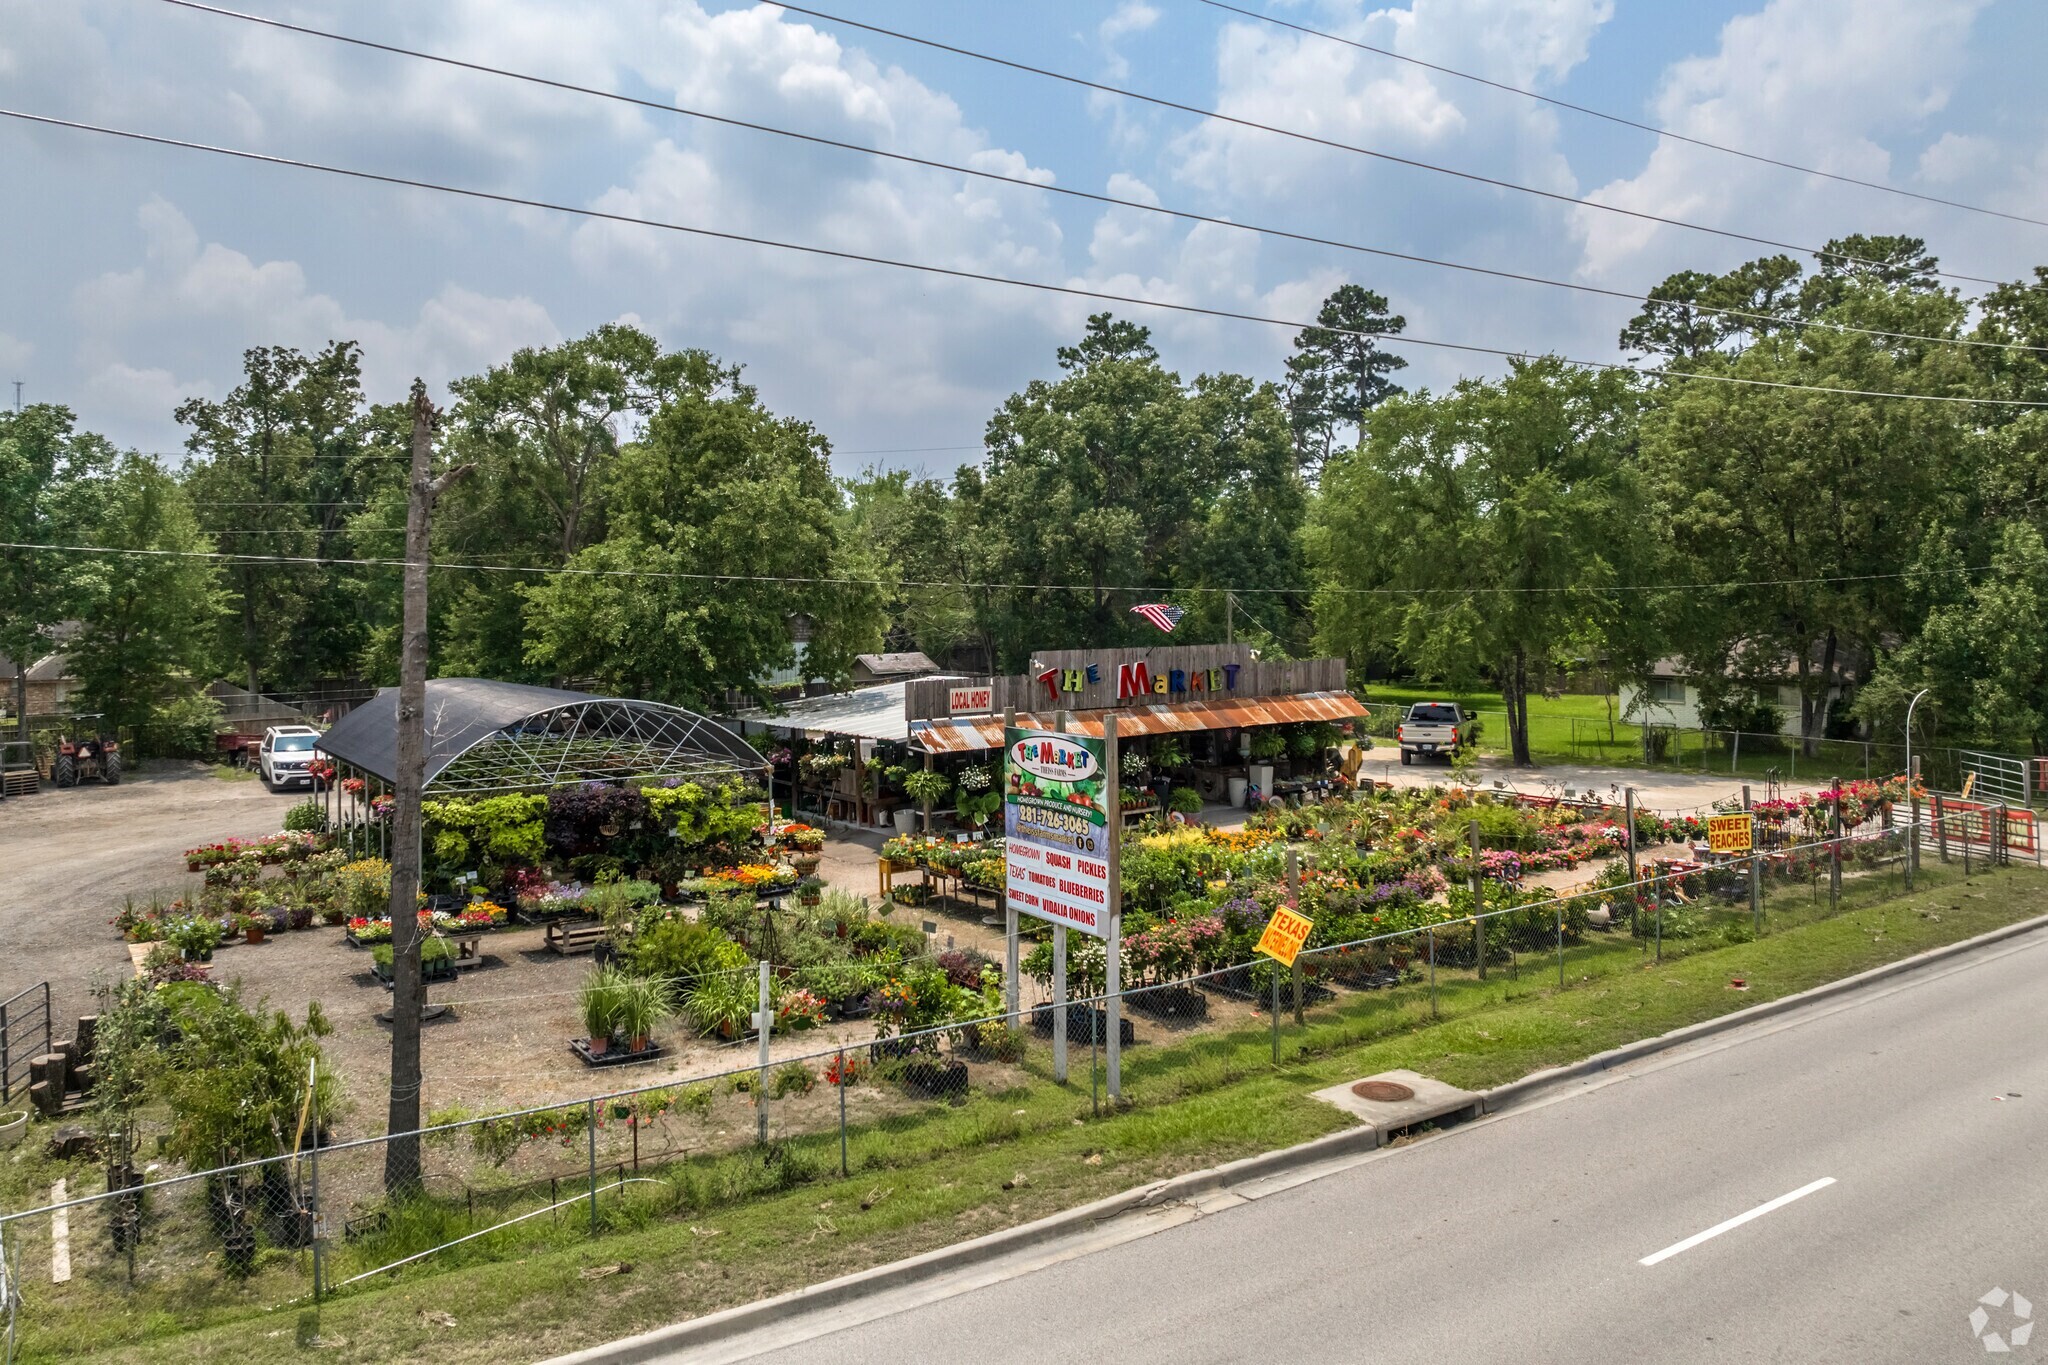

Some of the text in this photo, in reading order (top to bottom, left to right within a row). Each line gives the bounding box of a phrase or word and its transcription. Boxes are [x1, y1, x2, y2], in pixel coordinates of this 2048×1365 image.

[1037, 662, 1101, 700] THE
[951, 690, 991, 711] LOCAL HONEY
[1017, 743, 1039, 762] THE
[1054, 768, 1067, 777] FARMS
[1016, 796, 1044, 806] HOMEGROWN
[1043, 799, 1063, 810] PRODUCE
[1063, 803, 1072, 812] AND
[1019, 804, 1089, 836] 281-726-3065
[1709, 817, 1749, 832] SWEET
[1710, 832, 1750, 850] PEACHES
[1008, 843, 1107, 880] HOMEGROWN SQUASH PICKLES
[1009, 863, 1105, 904] TEXAS TOMATOES BLUEBERRIES
[1008, 888, 1096, 927] SWEET CORN VIDALIA ONIONS
[1273, 911, 1309, 940] TEXAS
